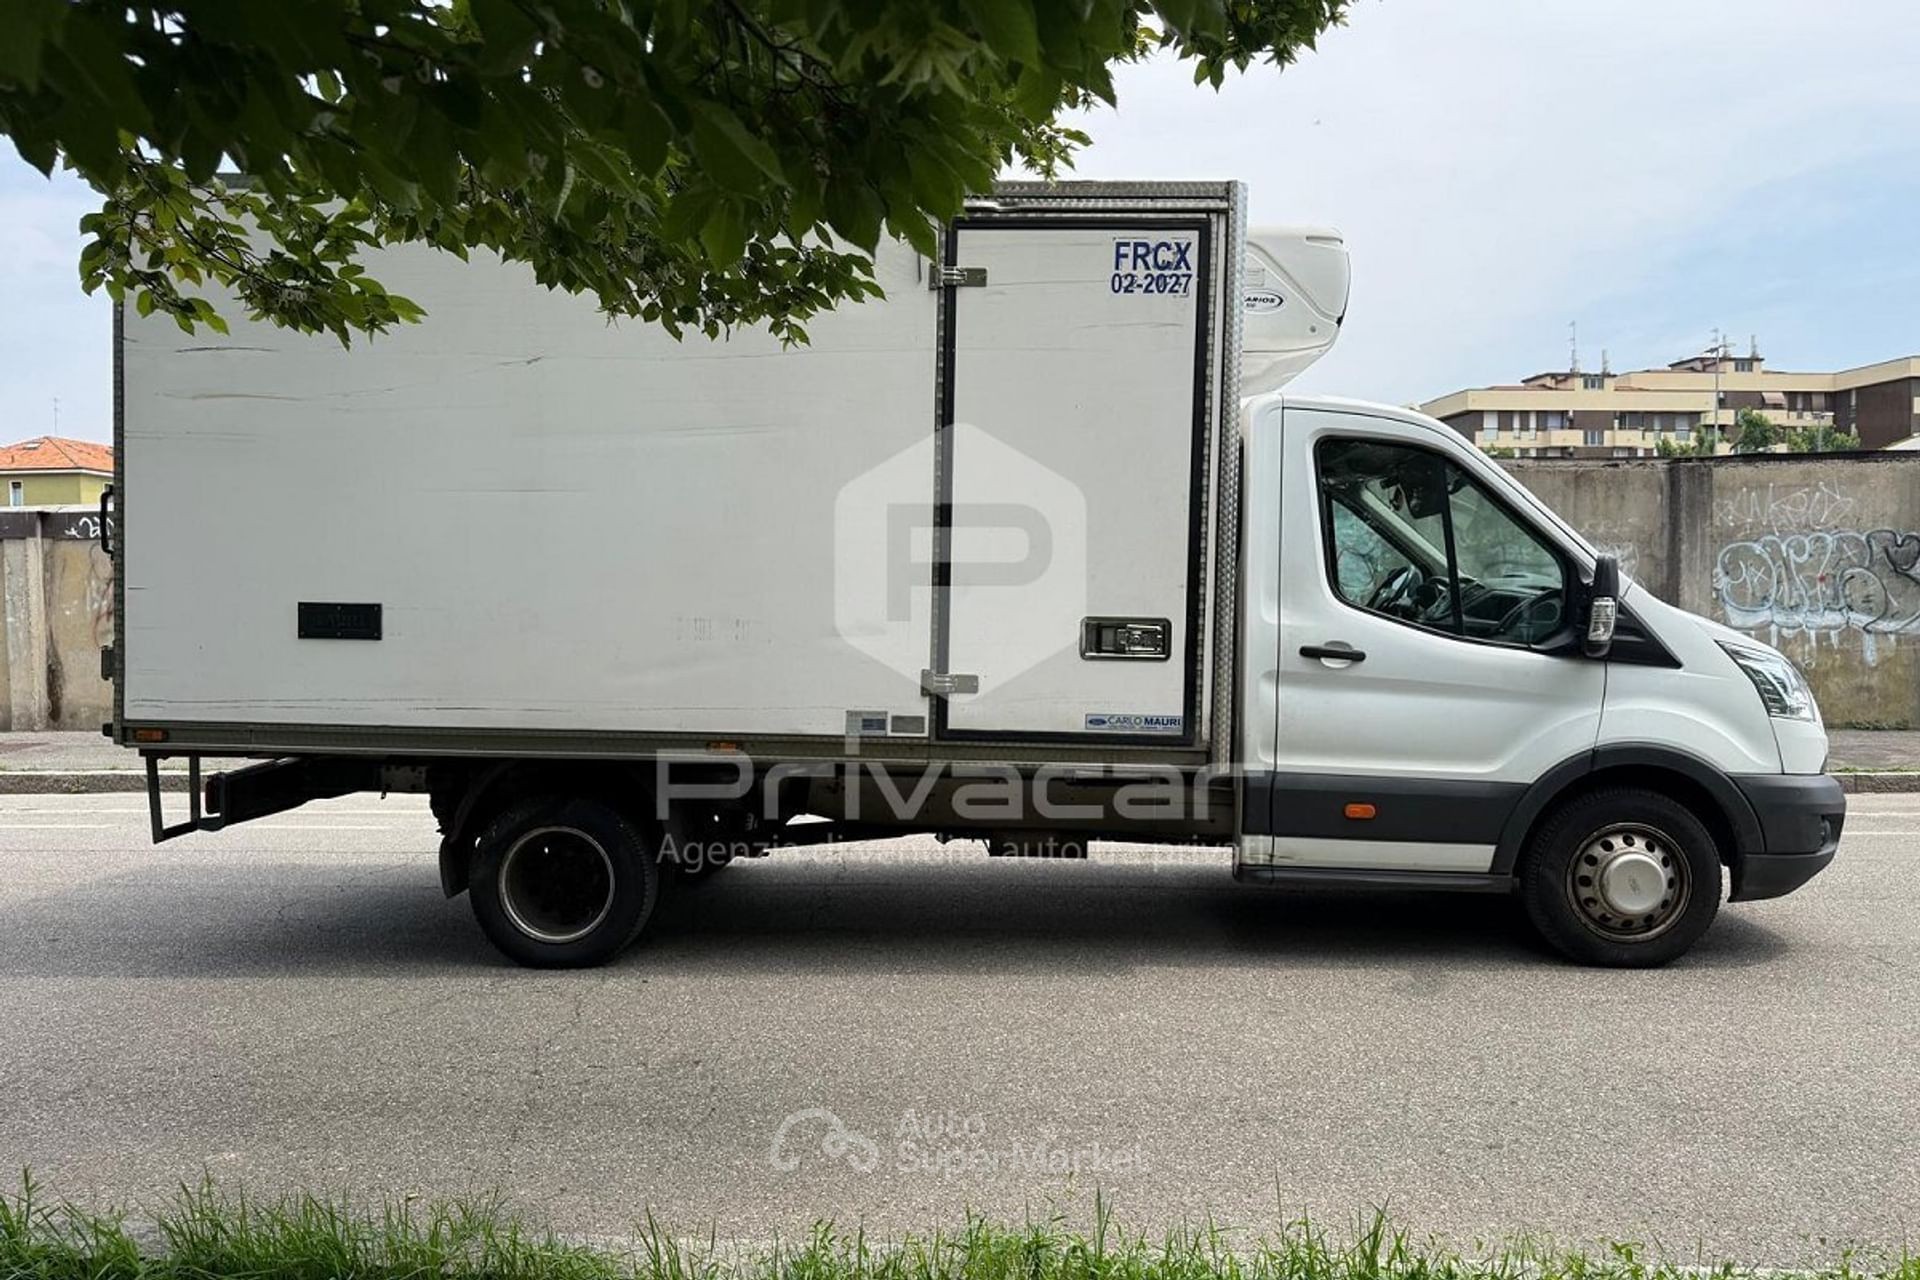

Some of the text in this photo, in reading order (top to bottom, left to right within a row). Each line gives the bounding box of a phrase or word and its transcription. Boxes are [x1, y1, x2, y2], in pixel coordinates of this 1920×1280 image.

[1114, 241, 1192, 271] FRCX
[1111, 273, 1192, 294] 02-2027
[1244, 296, 1276, 304] ARIOS
[1144, 717, 1181, 727] MAURI
